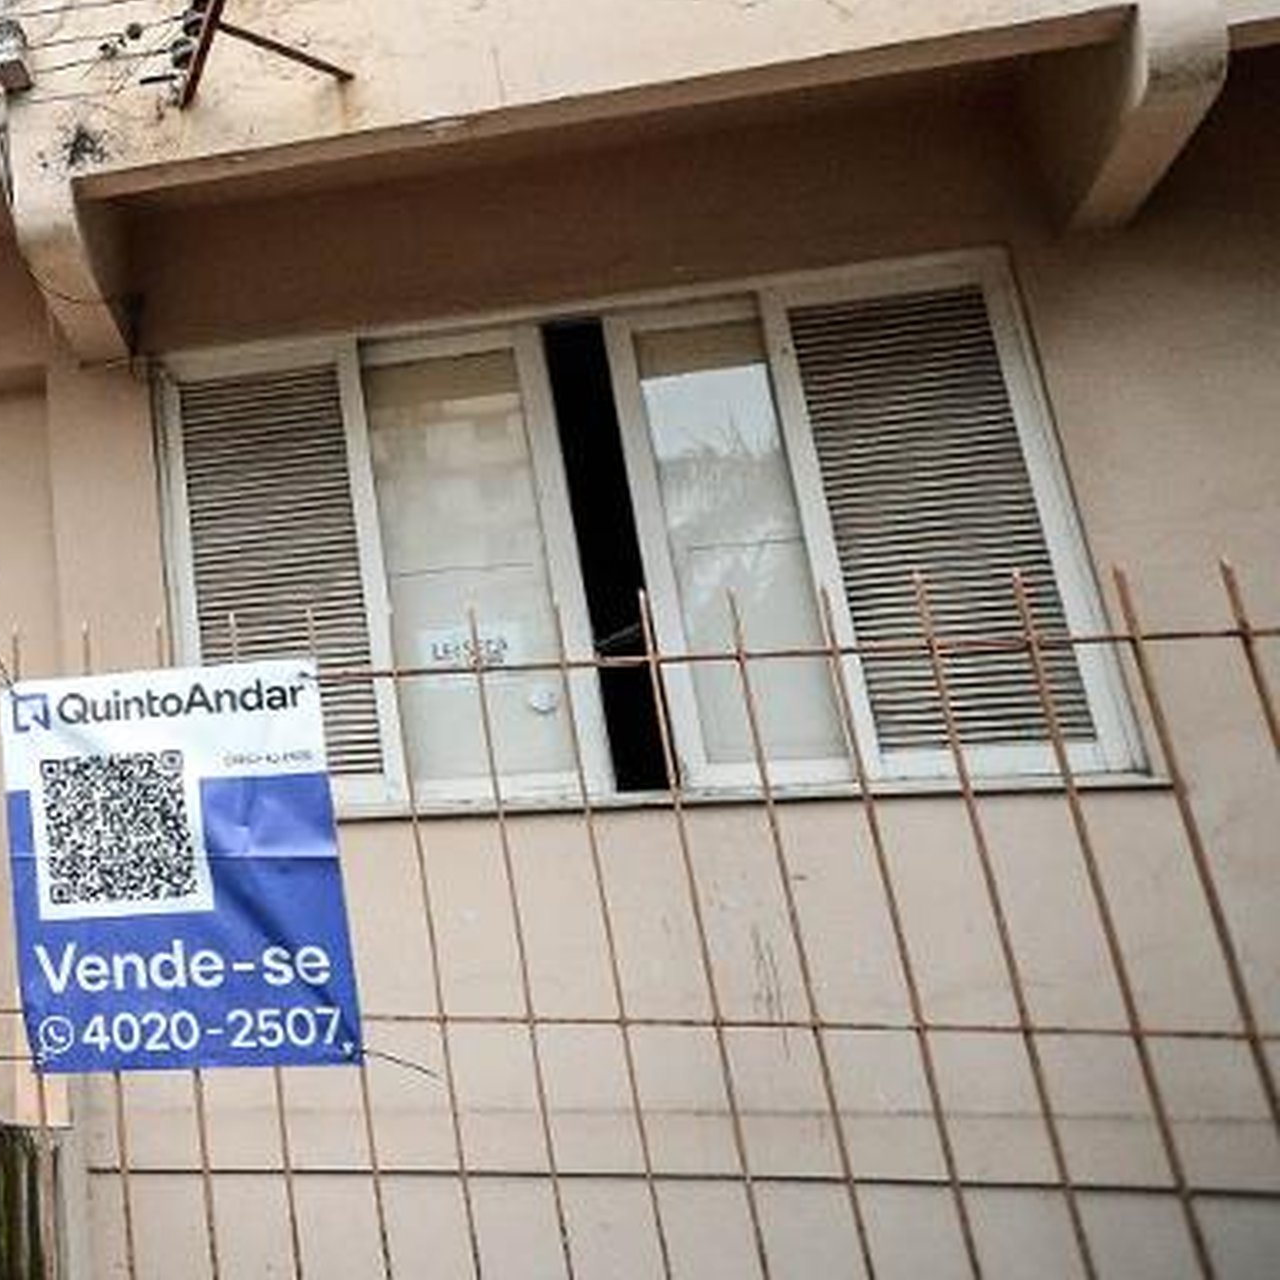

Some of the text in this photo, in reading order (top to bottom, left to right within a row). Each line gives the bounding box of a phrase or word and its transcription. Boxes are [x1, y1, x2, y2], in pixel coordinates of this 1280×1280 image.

[56, 678, 305, 724] QuintoAndar
[34, 939, 331, 994] Vende-se
[82, 1007, 340, 1052] 4020-2507
